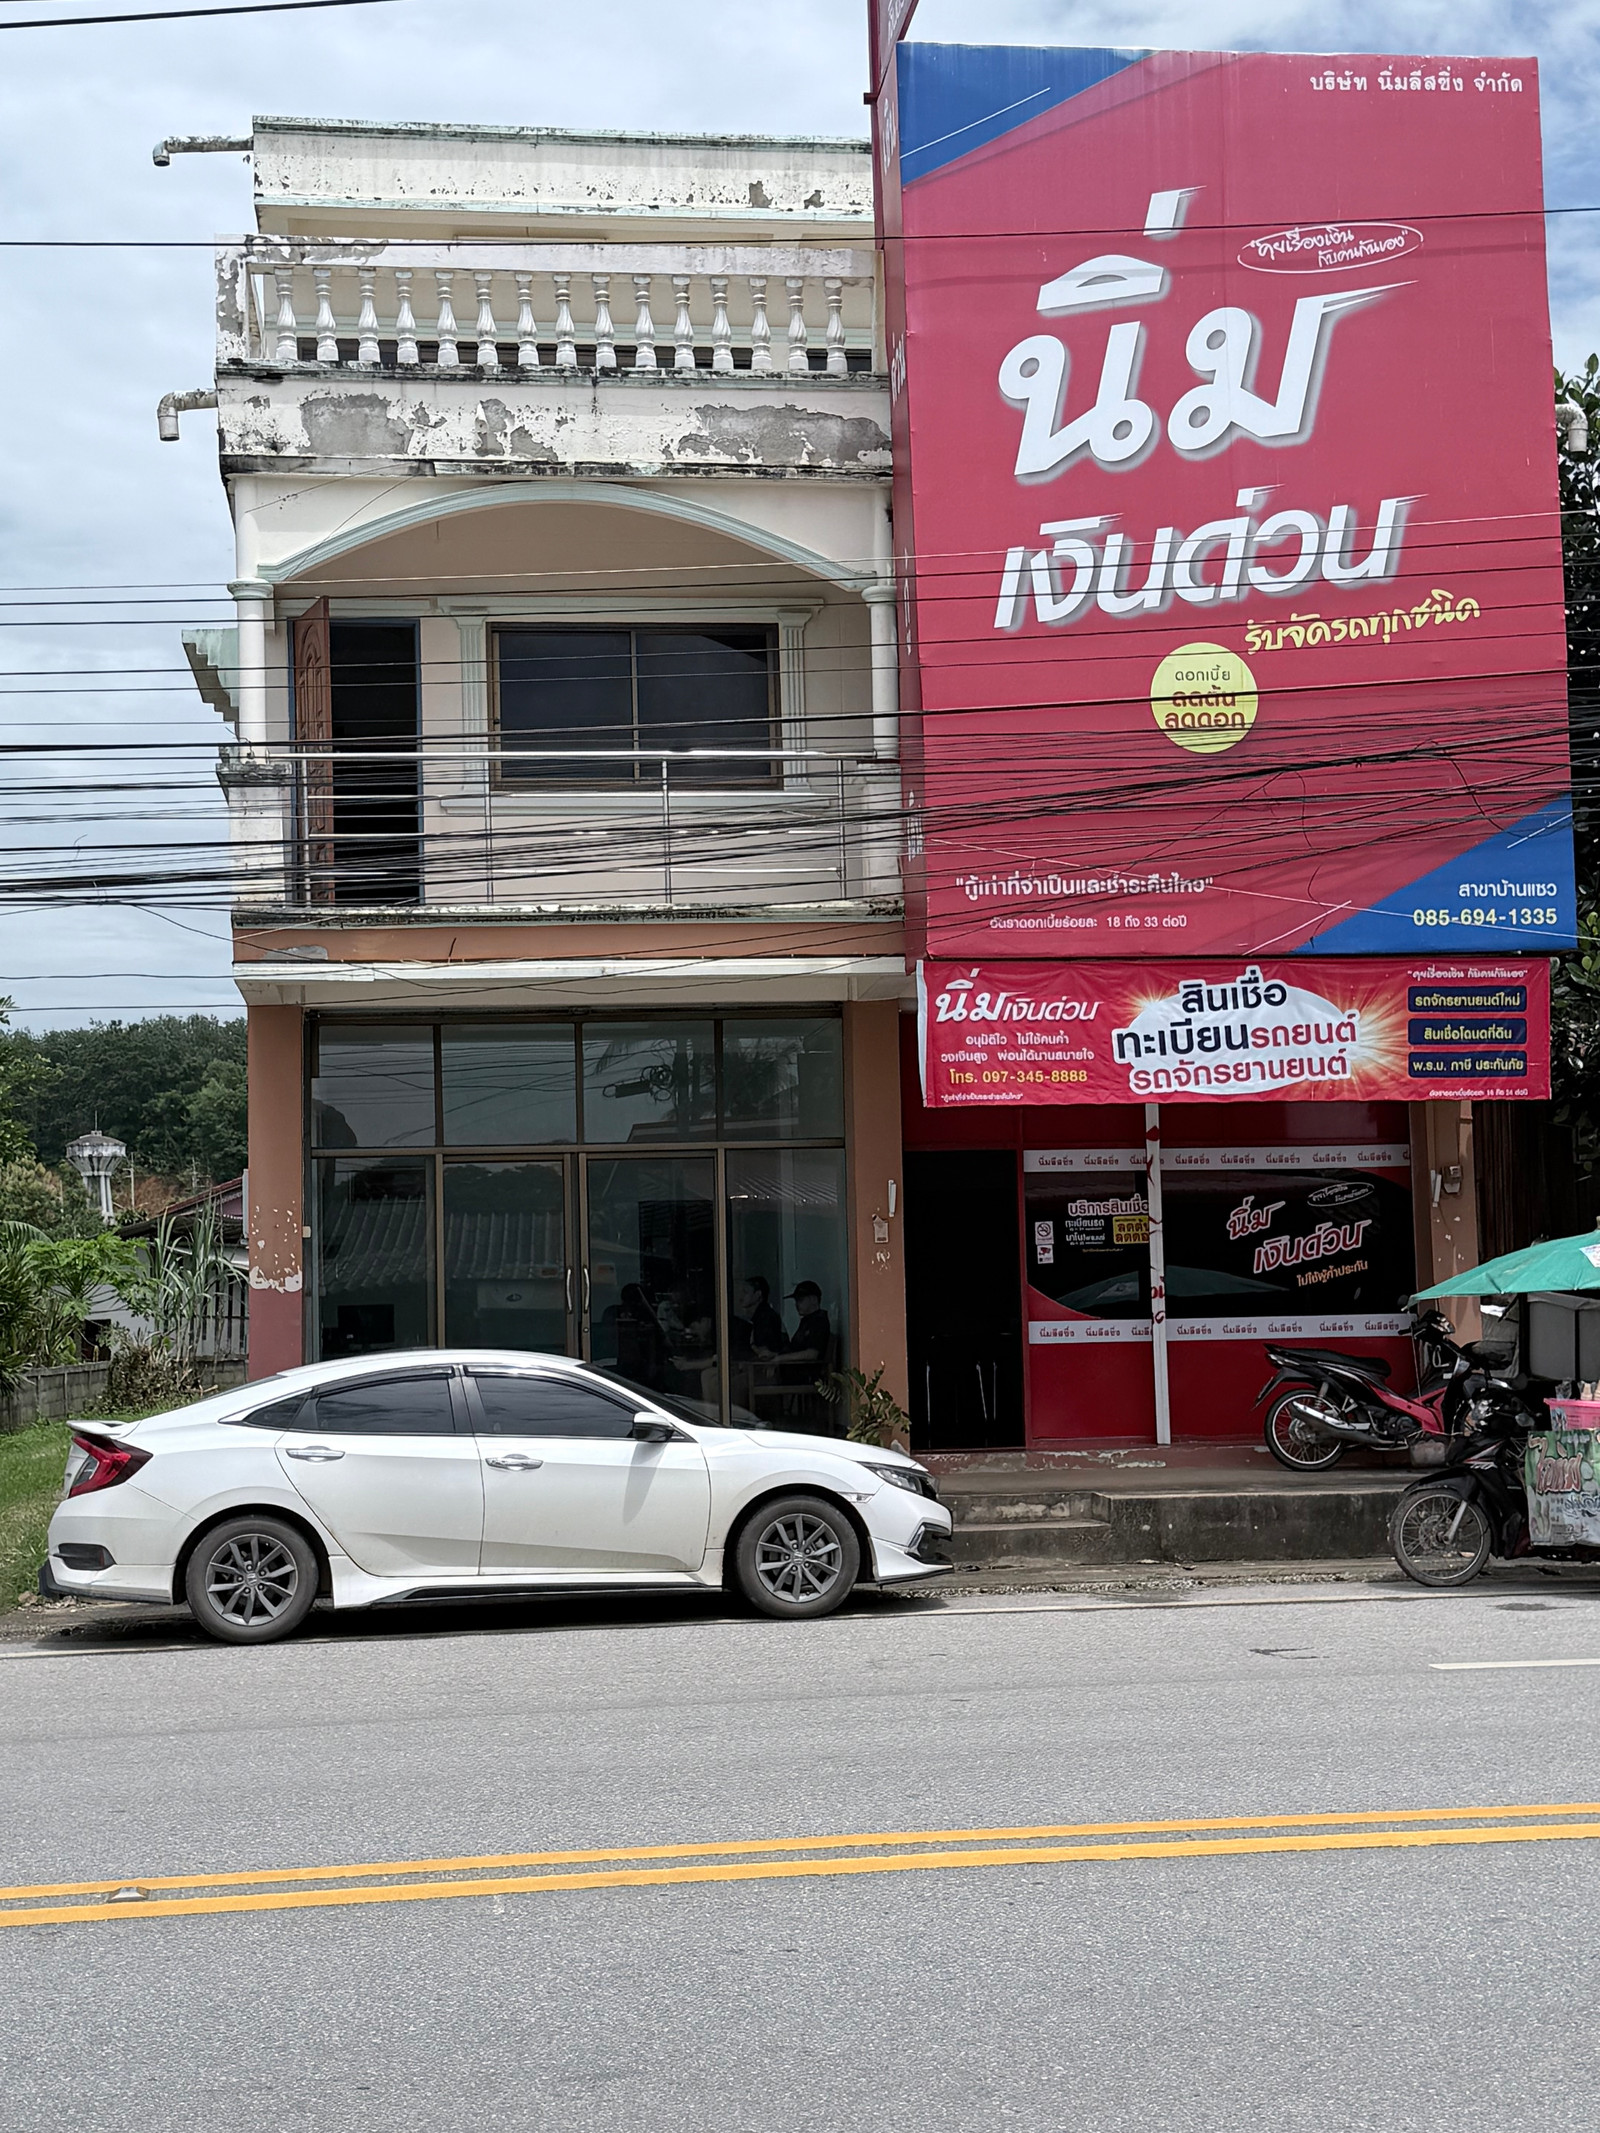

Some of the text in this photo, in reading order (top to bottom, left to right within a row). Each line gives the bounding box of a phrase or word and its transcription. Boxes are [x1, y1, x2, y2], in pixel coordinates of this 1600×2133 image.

[1309, 64, 1524, 92] บริษัท นิ่มลีสซิ่ง จำกัด
[998, 185, 1418, 476] นิ่ม
[993, 484, 1428, 629] เงินด่วน
[1244, 588, 1481, 655] รับจัดรถทุกชนิด
[1174, 664, 1231, 682] ดอกเบี้ย
[1171, 684, 1237, 708] ลดต้น
[1163, 711, 1246, 731] ลดดอก
[1458, 879, 1557, 898] สาขาบ้านแซว
[1106, 915, 1121, 929] 18
[1125, 915, 1140, 928] ถึง
[1144, 915, 1158, 928] 33
[1162, 914, 1188, 929] ต่อปี
[1413, 908, 1558, 927] 085-694-1335
[1181, 968, 1288, 1015] สินเชื่อ
[1415, 991, 1521, 1007] รถจักรยานยนต์ใหม่
[1116, 1012, 1358, 1060] ทะเบียนรถยนต์
[940, 1047, 1095, 1065] วงเงินสูง ผ่อนได้นานสบายใจ
[1413, 1061, 1447, 1072] พ.ร.บ.
[1475, 1057, 1524, 1071] ประกันภัย
[949, 1068, 1088, 1084] โทร. 097-345-8888
[1133, 1048, 1348, 1091] รถจักรยานยนต์
[1068, 1194, 1149, 1216] บริการสินเชื่อ
[1226, 1196, 1286, 1240] นิ่ม
[1115, 1232, 1149, 1243] ลดดอ
[1253, 1219, 1372, 1274] เงินด่วน
